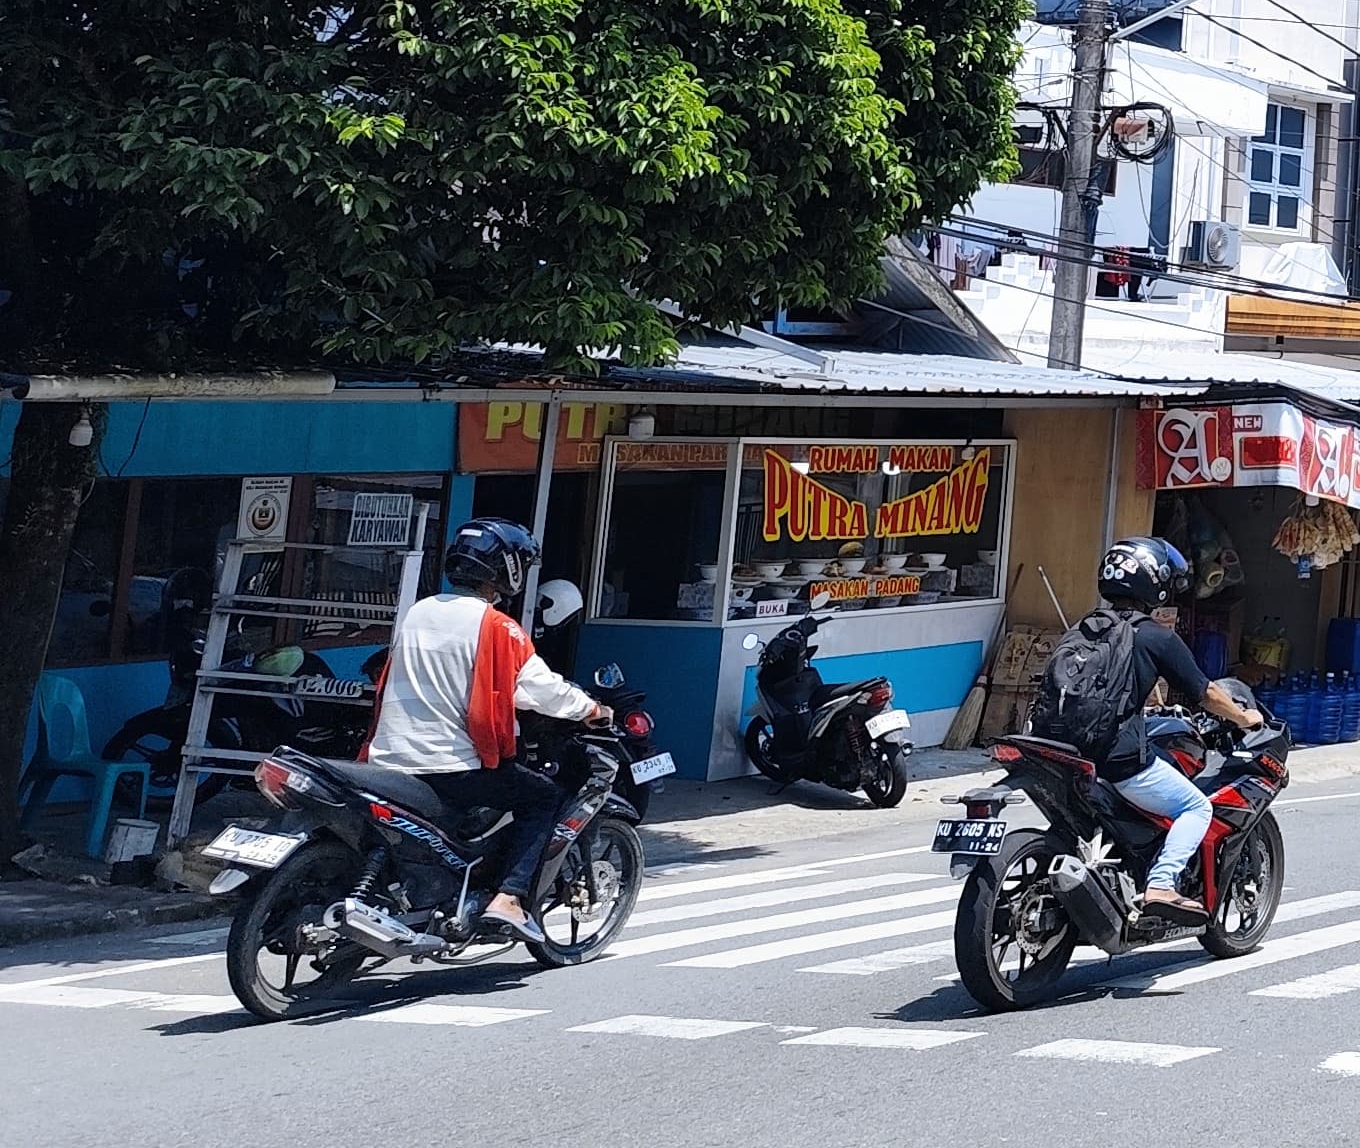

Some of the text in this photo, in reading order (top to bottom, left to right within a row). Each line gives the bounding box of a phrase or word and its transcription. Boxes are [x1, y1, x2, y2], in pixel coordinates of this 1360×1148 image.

[485, 402, 668, 442] PUTR
[1234, 417, 1261, 429] NEW
[577, 443, 684, 464] MSAKAN
[809, 445, 953, 474] RUMAH MAKAN
[763, 448, 991, 542] PUTRA MINANG
[350, 519, 408, 543] KARYAWAN
[875, 576, 921, 596] PADANG
[758, 604, 785, 615] BUKA
[937, 822, 1005, 837] KU 2605 NS
